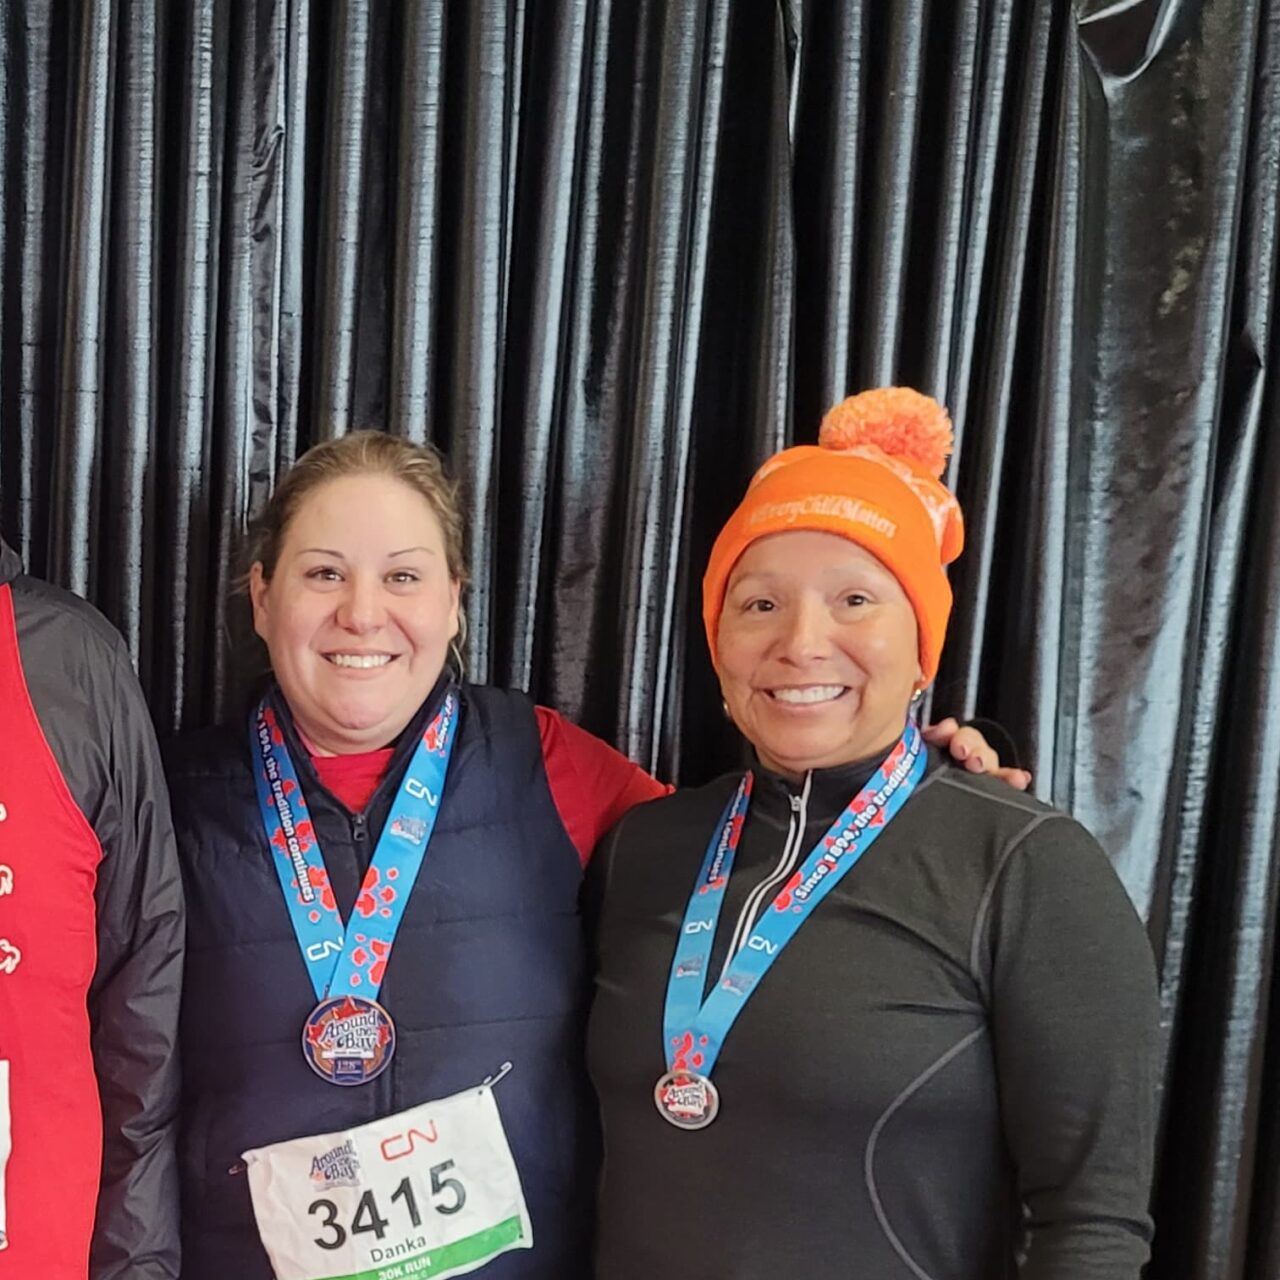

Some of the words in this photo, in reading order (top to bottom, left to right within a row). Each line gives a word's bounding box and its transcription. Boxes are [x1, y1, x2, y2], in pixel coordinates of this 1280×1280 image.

[257, 721, 272, 758] 1894,
[265, 757, 278, 780] the
[272, 780, 295, 837] tradition
[287, 837, 315, 902] continues
[794, 862, 829, 899] Since
[823, 828, 861, 863] 1894,
[853, 803, 878, 829] the
[872, 751, 915, 806] tradition
[684, 918, 713, 934] CN
[748, 935, 778, 954] CN
[320, 1010, 377, 1043] Around
[337, 1032, 376, 1051] Bay
[380, 1120, 438, 1162] CN
[309, 1139, 354, 1179] Around
[308, 1158, 467, 1251] 3415
[370, 1236, 427, 1263] Danka
[405, 1255, 432, 1274] RUN
